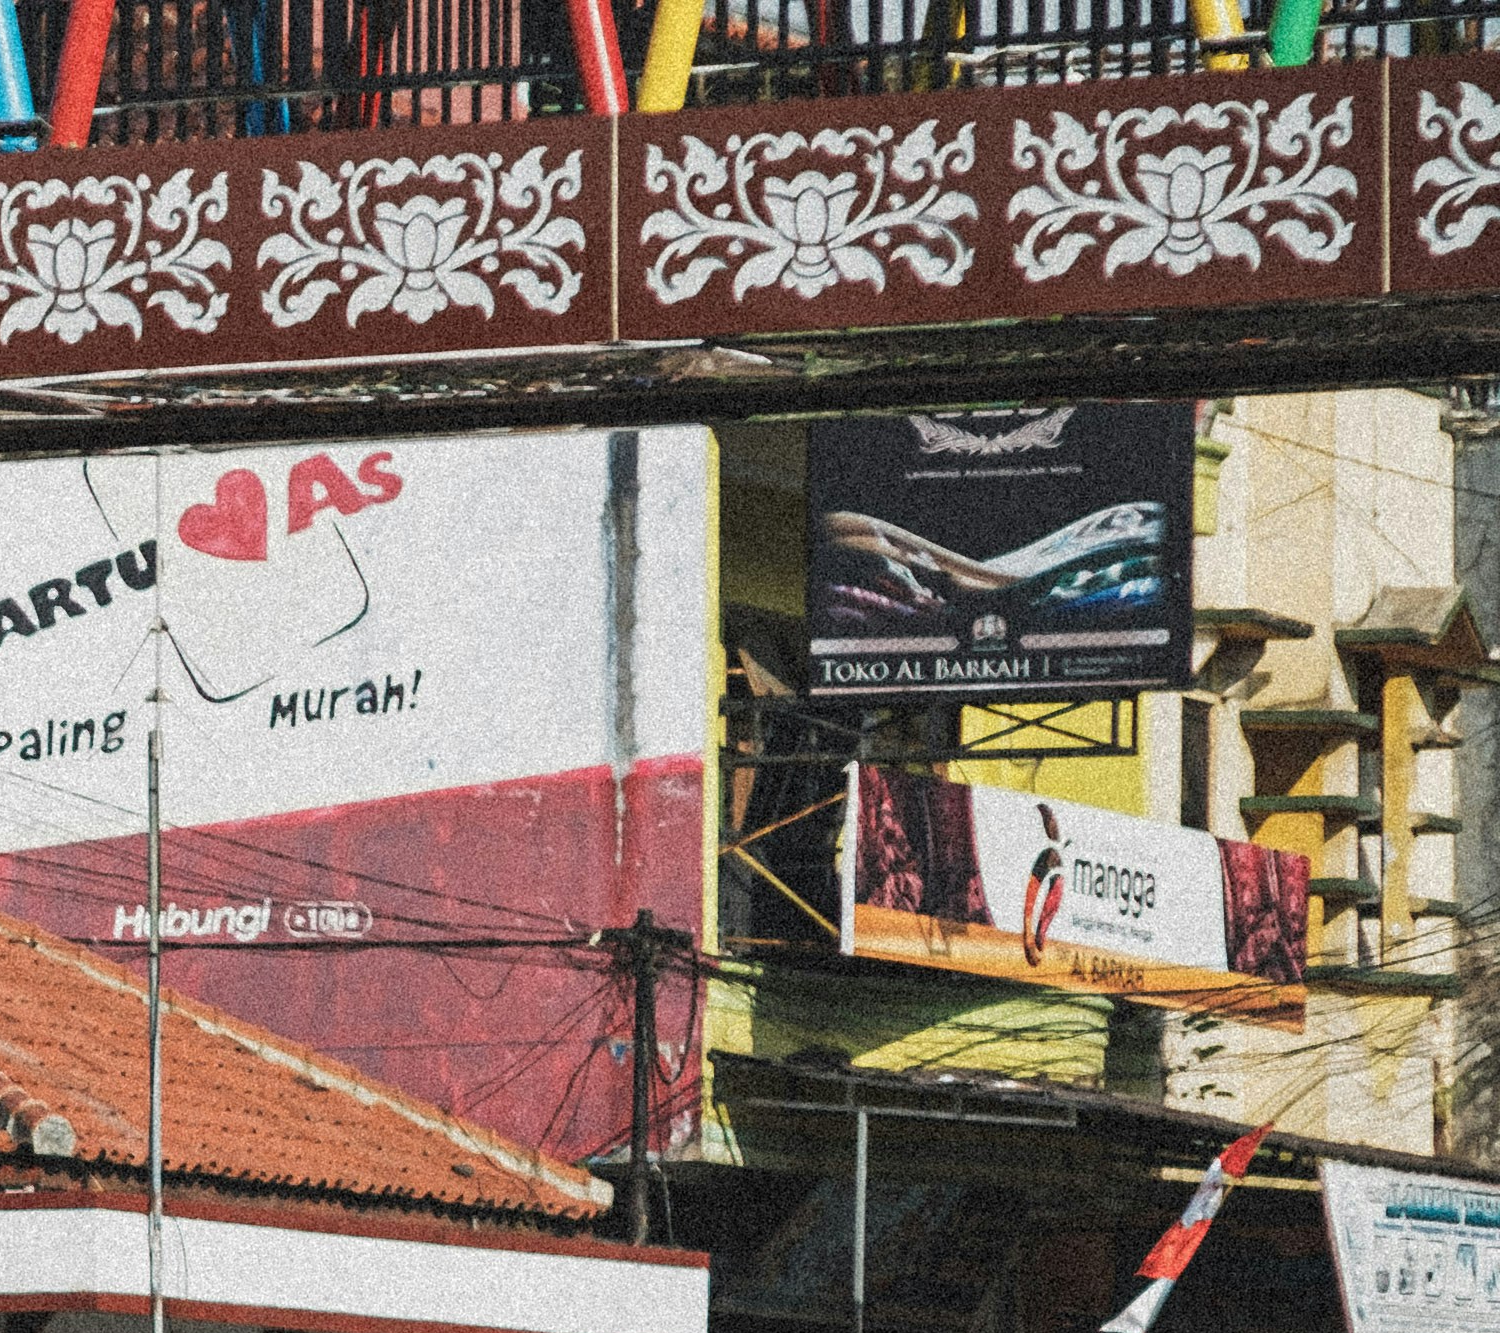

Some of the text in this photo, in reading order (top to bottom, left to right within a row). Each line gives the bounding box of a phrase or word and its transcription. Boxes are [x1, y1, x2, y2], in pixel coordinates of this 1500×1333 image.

[820, 657, 1030, 683] TOKO AL BARKAH
[270, 669, 421, 728] Murah!
[1073, 858, 1156, 918] mangga
[113, 897, 273, 942] Hubungi
